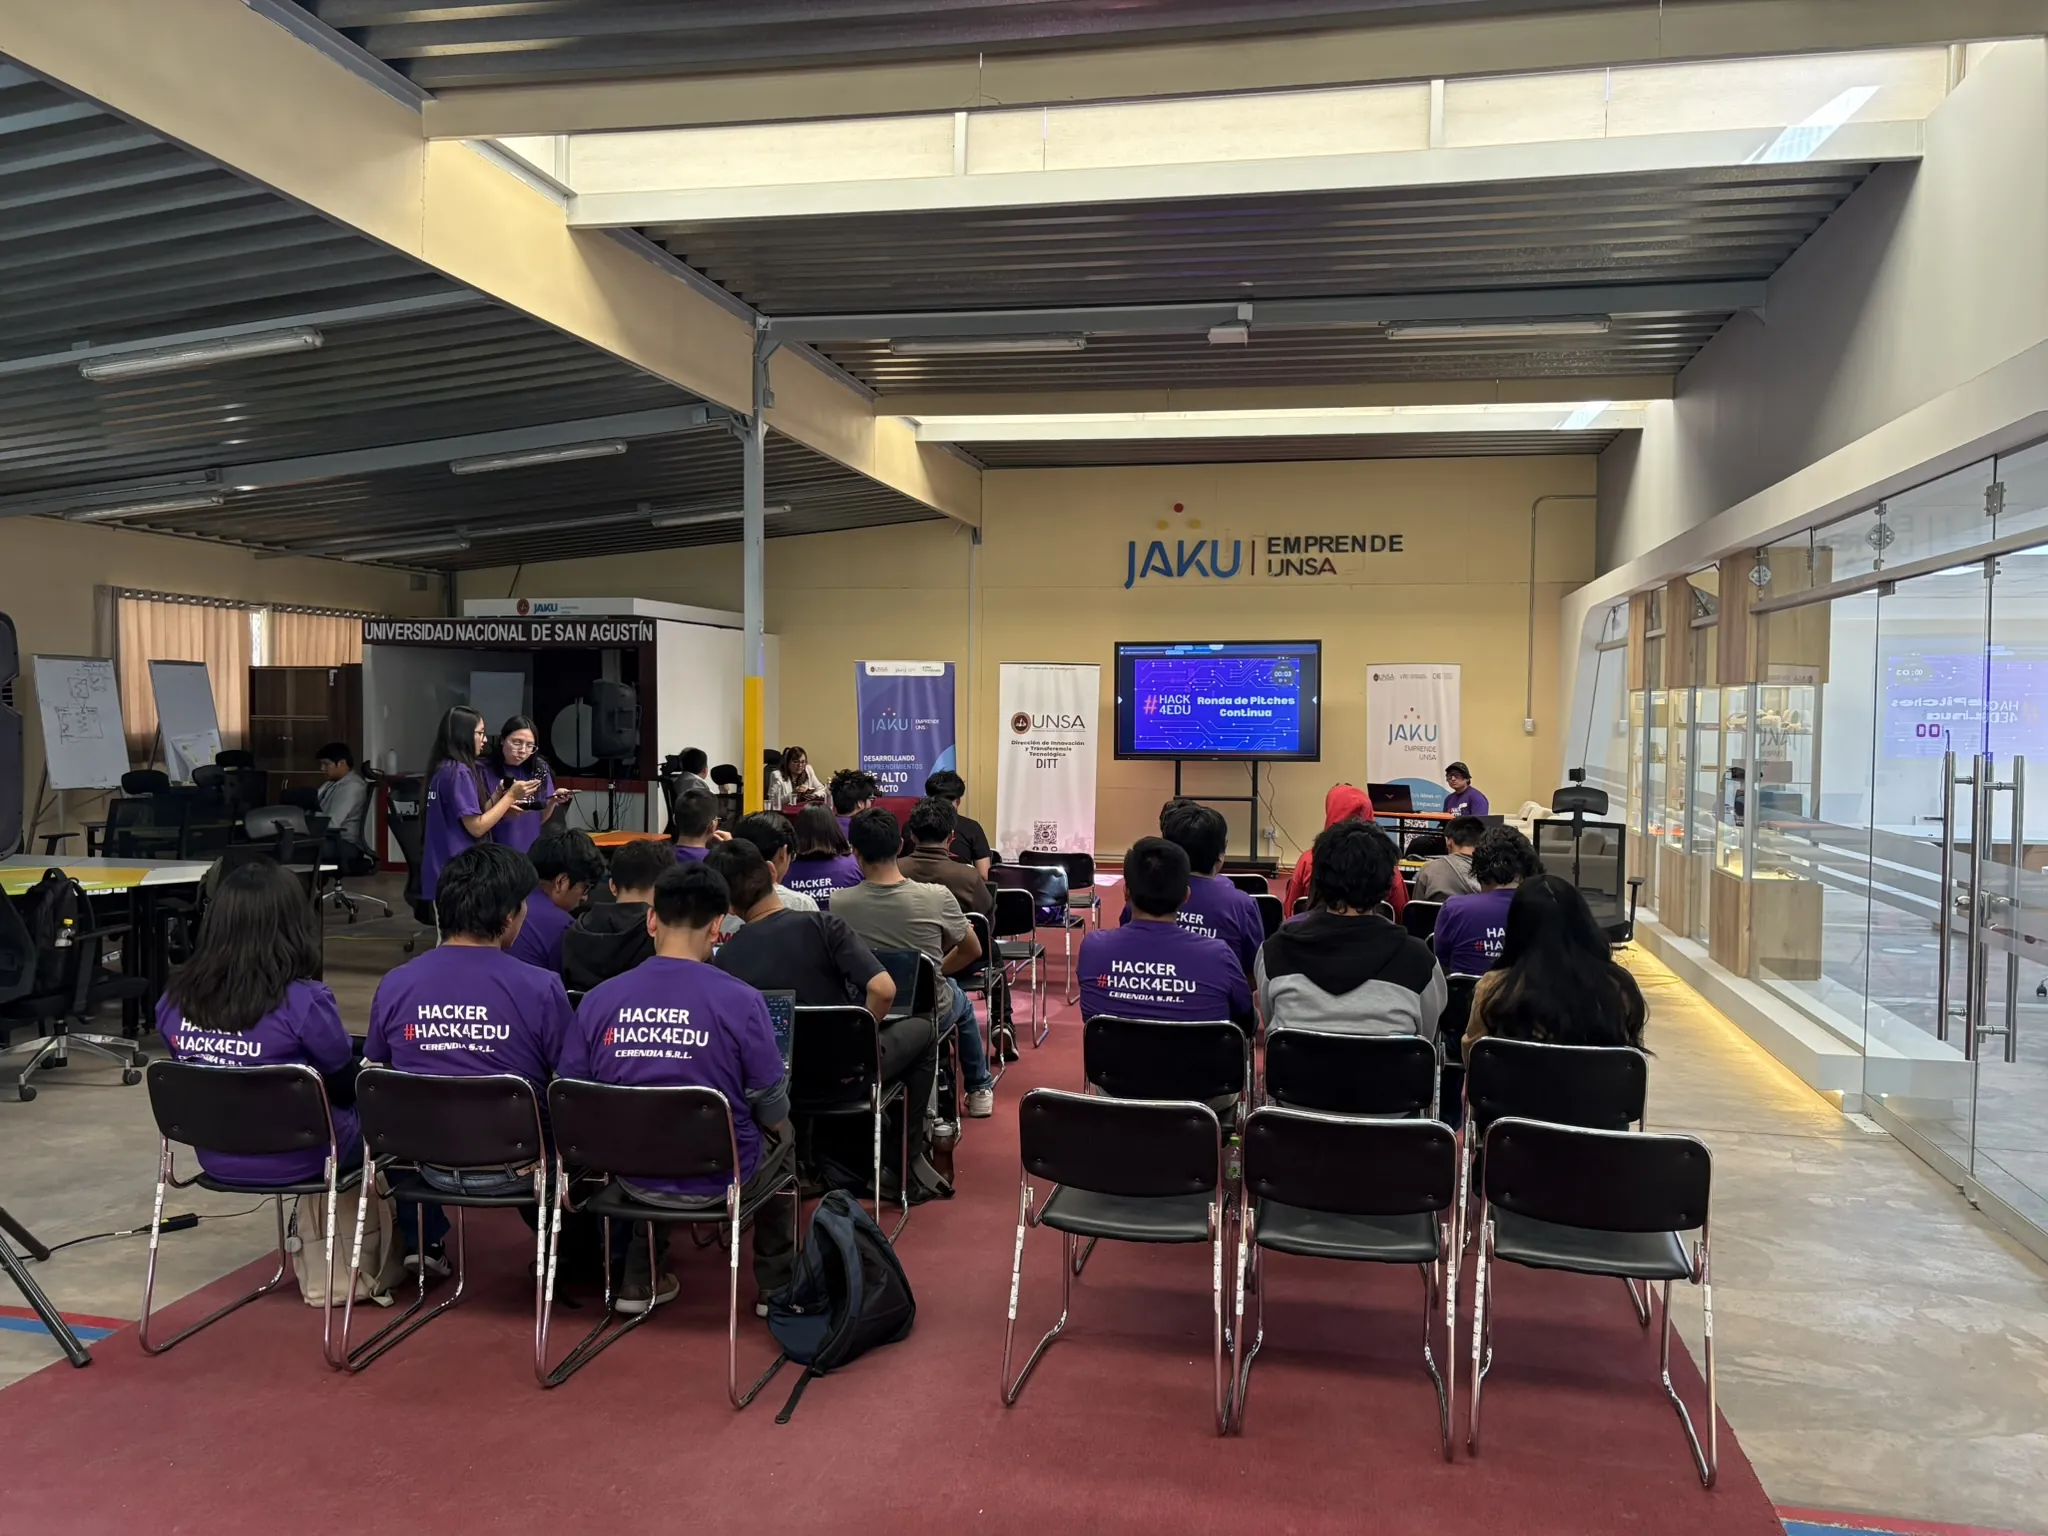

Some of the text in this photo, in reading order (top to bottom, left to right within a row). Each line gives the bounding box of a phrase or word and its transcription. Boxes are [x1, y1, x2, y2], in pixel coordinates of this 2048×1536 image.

[1267, 535, 1403, 554] EMPRENDE
[1124, 540, 1241, 589] JAKU
[1268, 558, 1337, 577] UNSA
[534, 603, 558, 614] JAKU
[365, 620, 653, 642] UNIVERSIDAD NACIONAL DE SAN AGUSTÍN
[1159, 694, 1191, 705] HACK
[1197, 695, 1295, 705] Ronda de Pitches
[1159, 705, 1191, 715] 4EDU
[1219, 708, 1272, 717] Continua
[870, 718, 909, 734] JAKU
[1032, 714, 1085, 729] UNSA
[1388, 724, 1437, 745] JAKU
[1036, 759, 1058, 769] DITT
[881, 771, 908, 783] ALTO
[791, 878, 832, 889] HACKER
[1111, 960, 1177, 976] HACKER
[1097, 974, 1196, 993] #HACK4EDU
[1109, 991, 1185, 1003] CERENDIA S.R.L.
[418, 1004, 488, 1020] HACKER
[619, 1008, 690, 1024] HACKER
[404, 1023, 510, 1040] #HACK4EDU
[603, 1027, 709, 1047] #HACK4EDU
[420, 1042, 467, 1051] CERENDIA
[615, 1049, 692, 1059] CERENDIA S.R.L.
